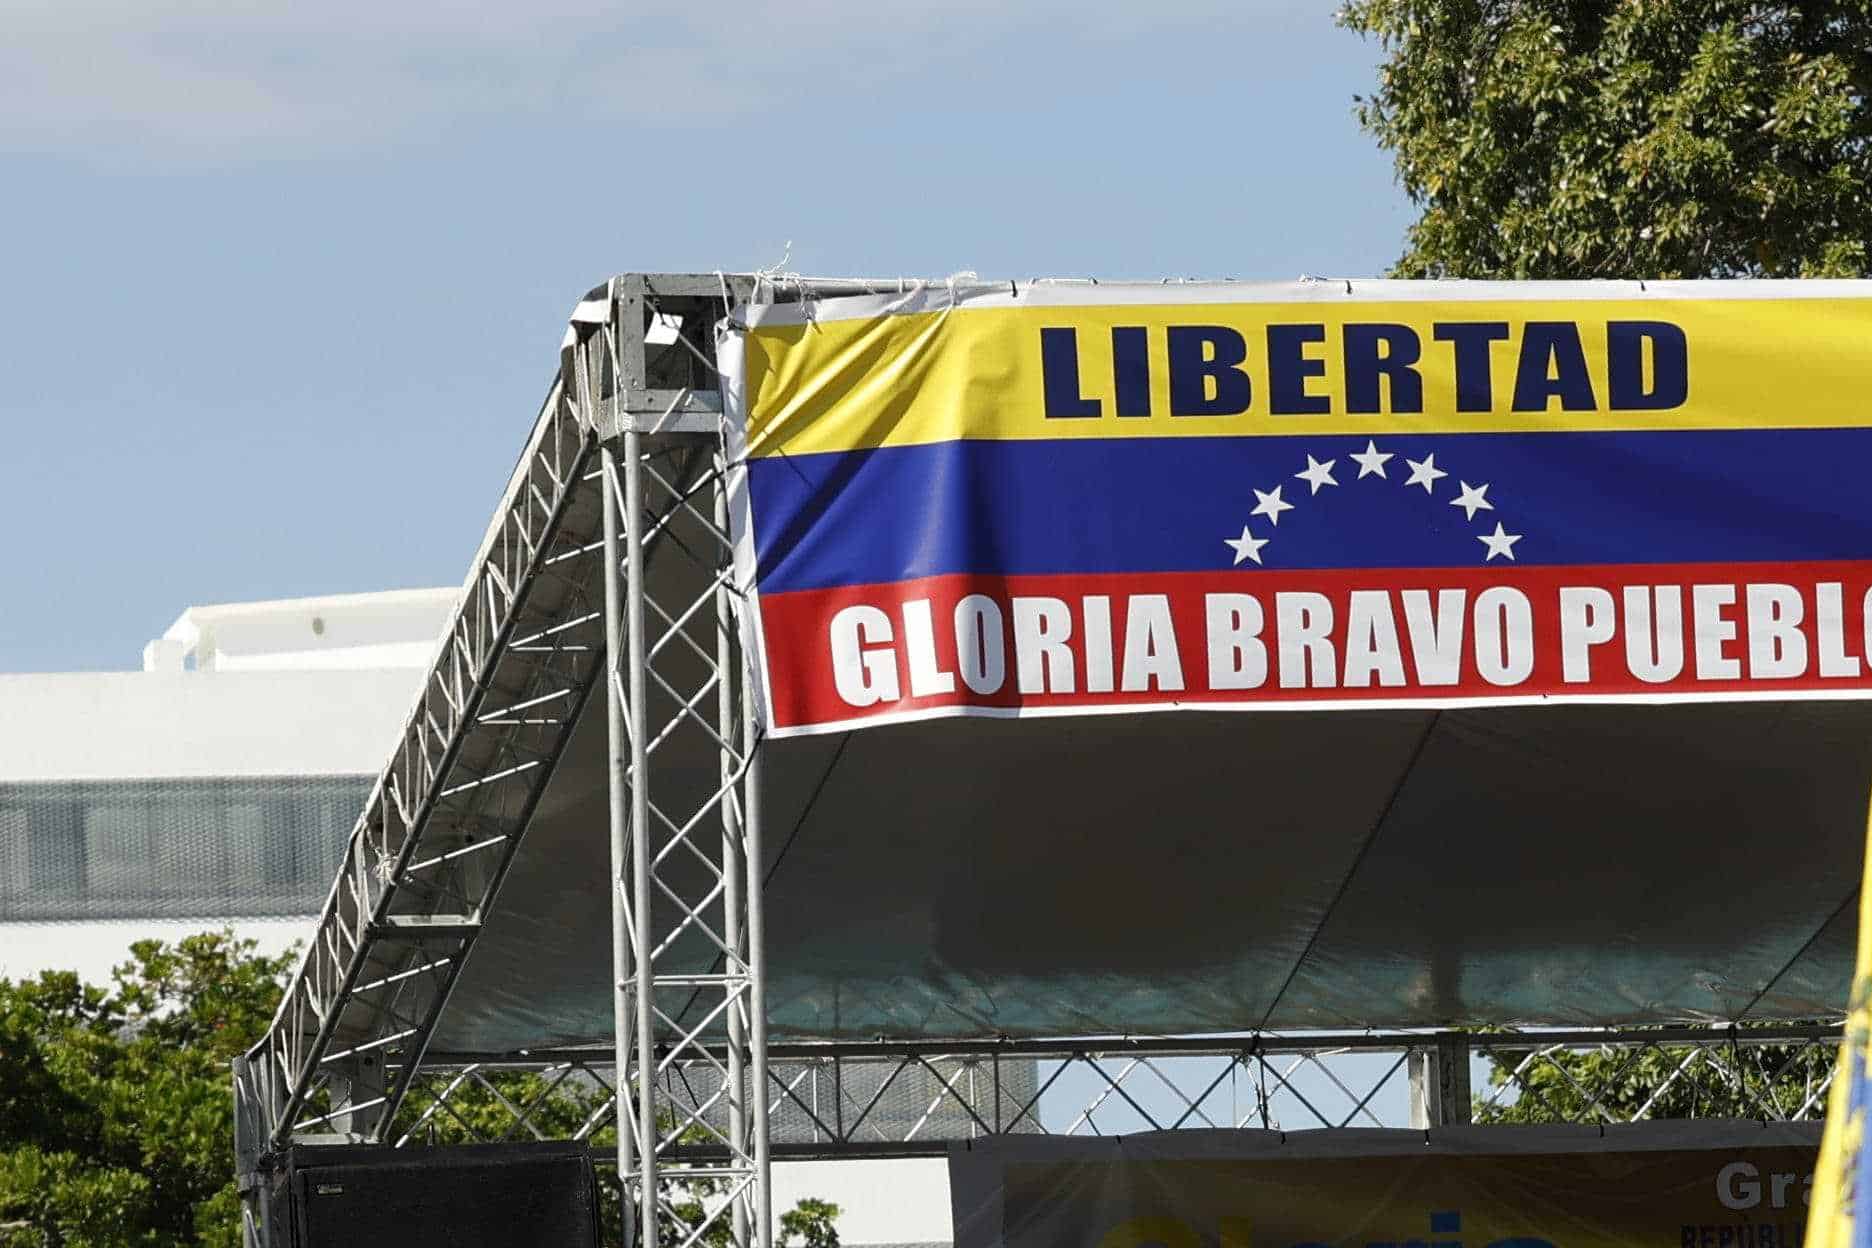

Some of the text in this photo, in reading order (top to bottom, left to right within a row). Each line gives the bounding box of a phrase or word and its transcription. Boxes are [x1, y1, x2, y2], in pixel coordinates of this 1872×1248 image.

[1040, 320, 1688, 419] LIBERTAD
[830, 592, 1186, 707] GLORIA
[1208, 586, 1532, 690] BRAVO
